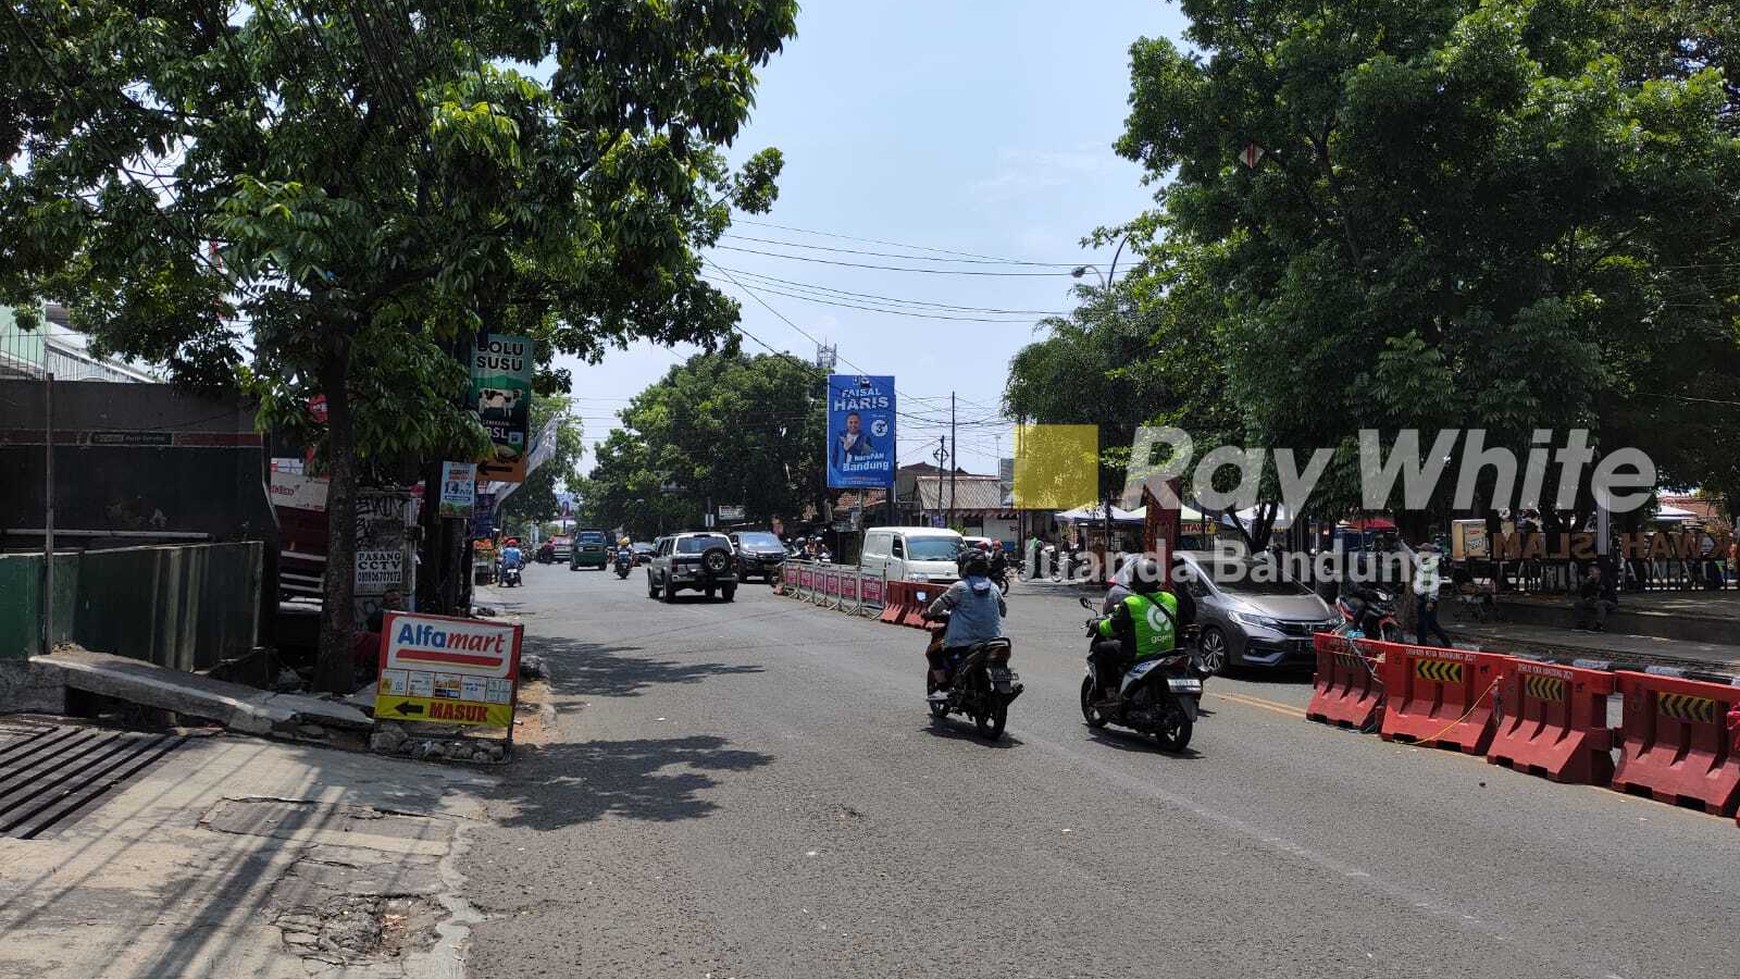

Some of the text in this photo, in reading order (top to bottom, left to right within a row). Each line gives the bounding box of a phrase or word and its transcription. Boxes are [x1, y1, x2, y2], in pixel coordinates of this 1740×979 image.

[476, 355, 523, 371] SUSU
[842, 388, 882, 398] FAISAL
[833, 396, 889, 412] HARIS
[842, 461, 889, 472] Bandung
[358, 552, 401, 561] PASANG
[358, 561, 401, 570] CCTV
[397, 623, 505, 653] Alfamart
[429, 702, 489, 723] MASUK
